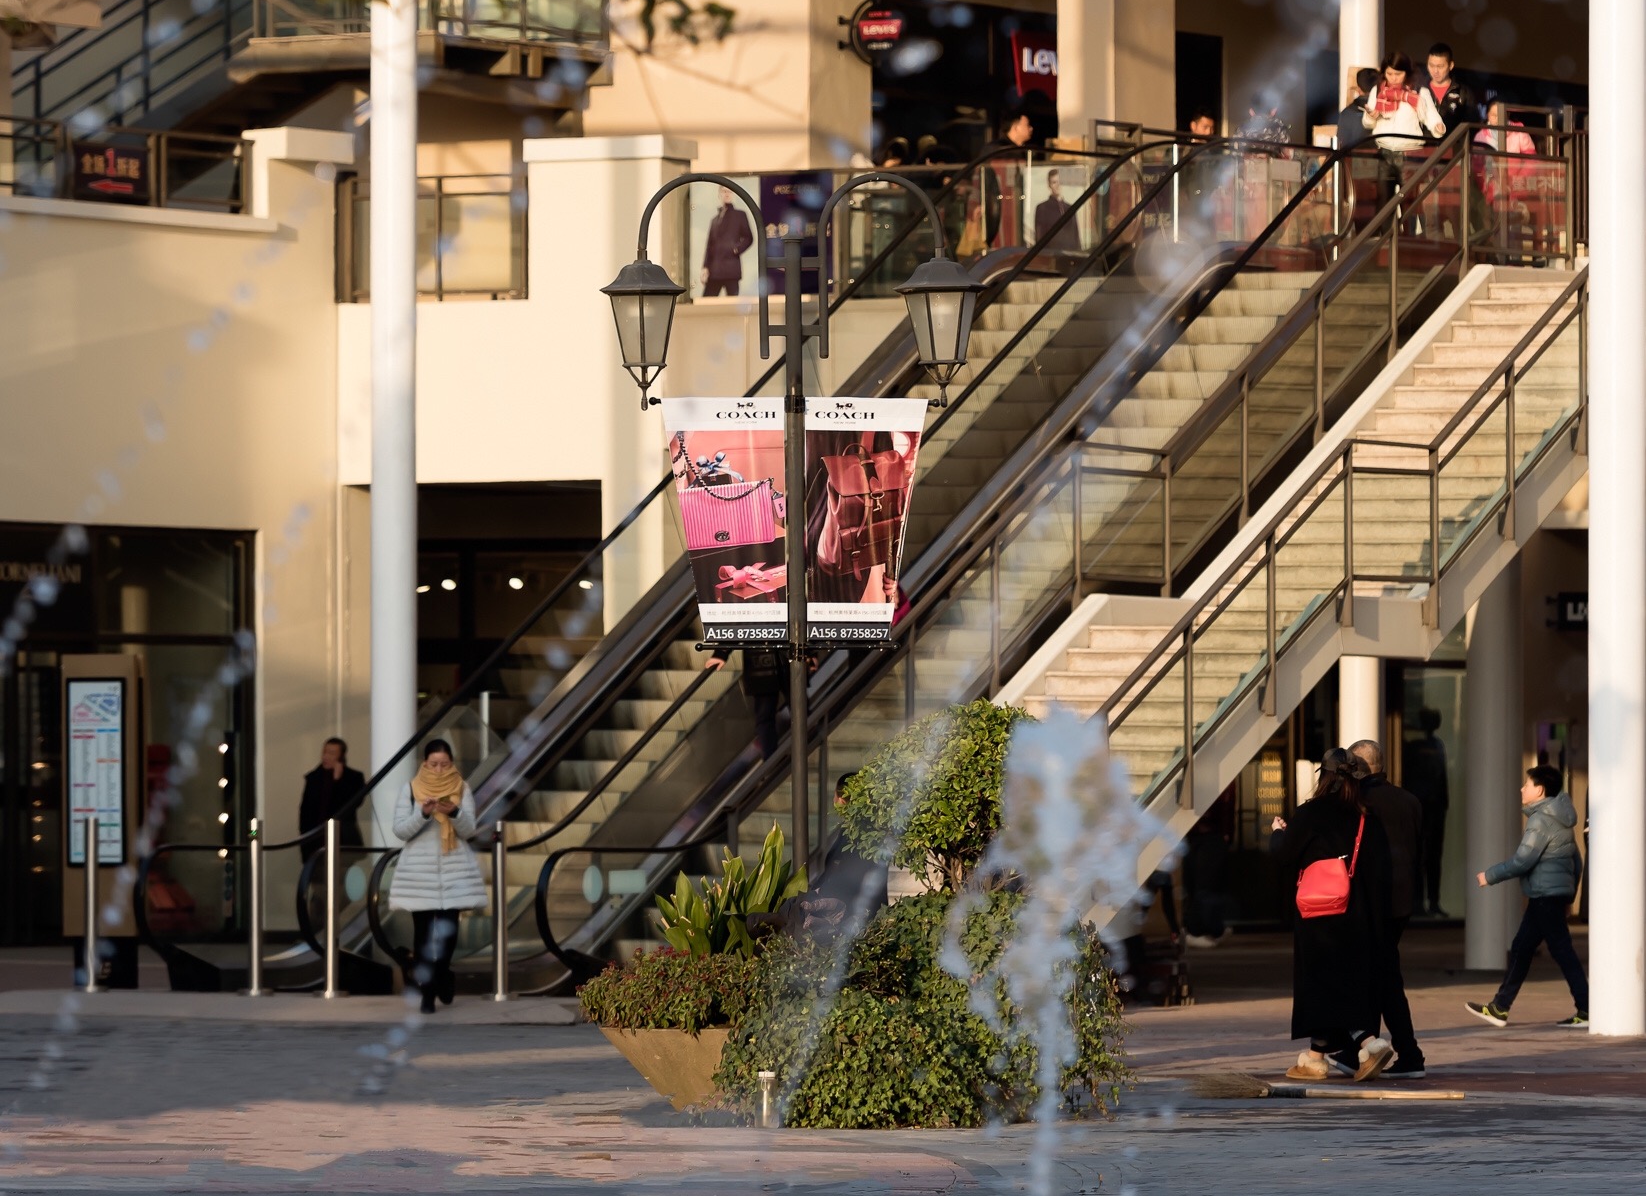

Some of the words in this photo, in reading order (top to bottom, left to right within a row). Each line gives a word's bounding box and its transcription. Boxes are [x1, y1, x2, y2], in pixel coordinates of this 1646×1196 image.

[716, 410, 776, 420] COACH
[815, 410, 875, 420] COACH
[706, 627, 735, 639] A156
[737, 628, 786, 639] 87358257
[809, 626, 838, 638] A156
[840, 628, 889, 639] 87358257
